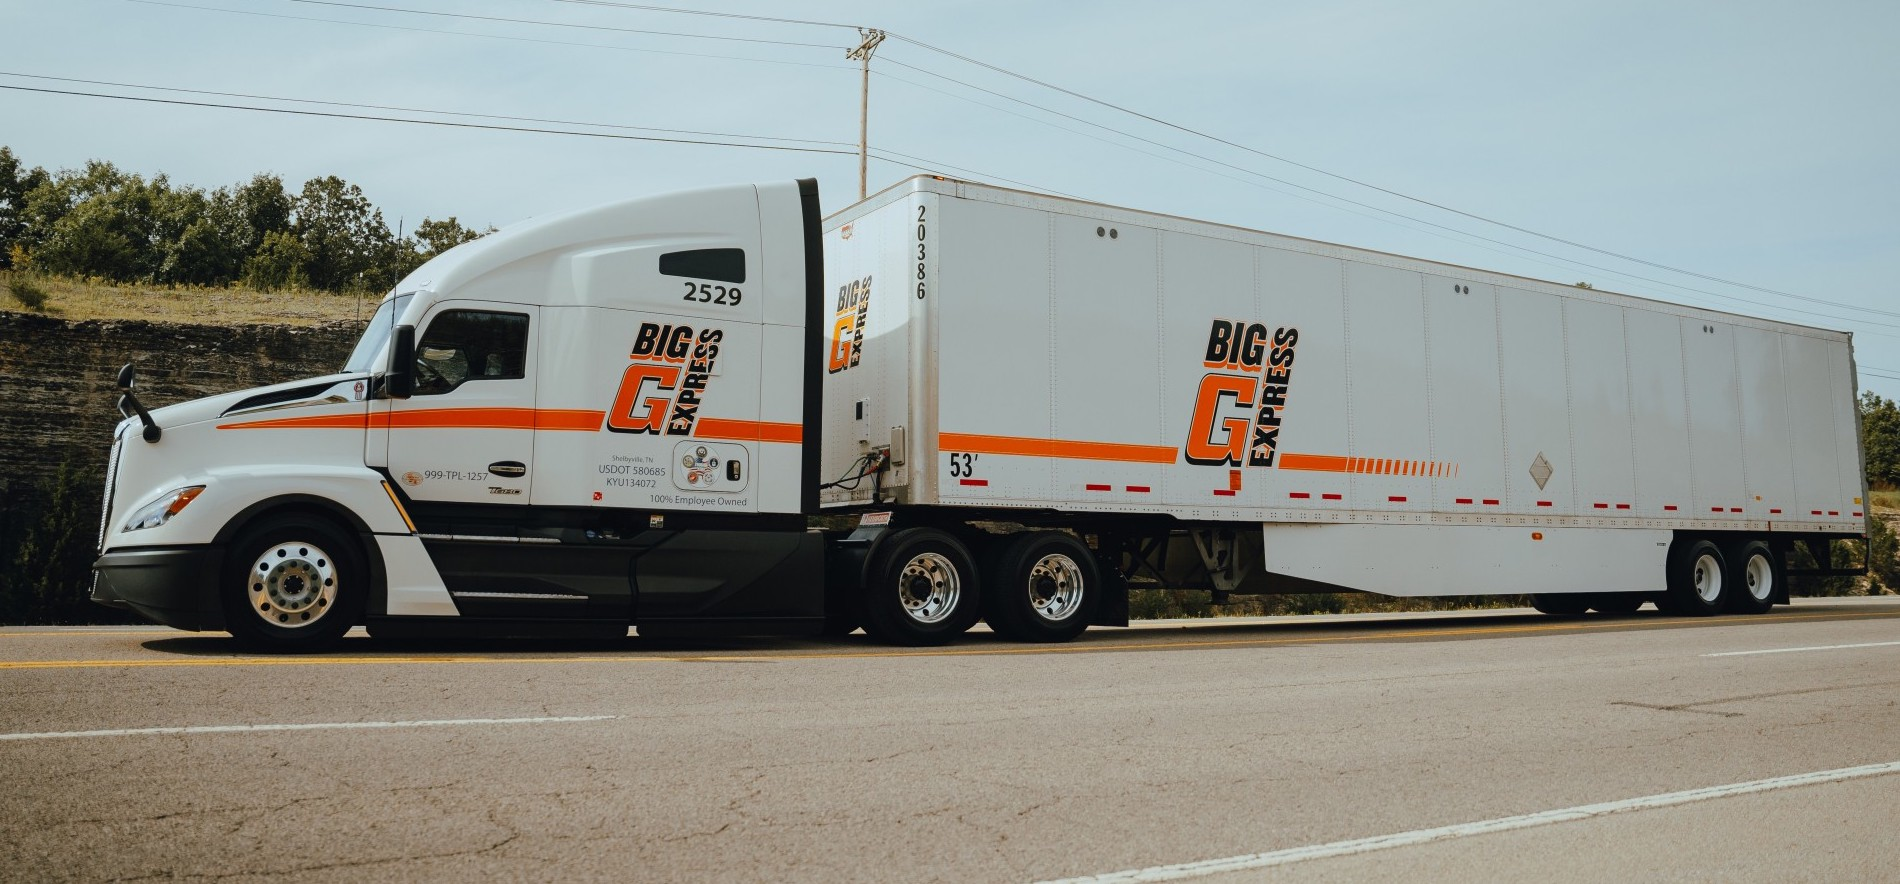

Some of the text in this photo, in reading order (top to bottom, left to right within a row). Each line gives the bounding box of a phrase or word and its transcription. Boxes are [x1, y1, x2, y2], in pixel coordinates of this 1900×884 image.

[917, 205, 926, 299] 20386
[683, 282, 742, 306] 2529
[836, 279, 860, 316] BIG
[629, 321, 694, 363] BIG
[849, 274, 873, 369] EXPRESS
[828, 313, 856, 375] G
[1203, 318, 1268, 373] BIG
[606, 362, 683, 436] G
[663, 328, 724, 437] EXPRESS
[1246, 327, 1299, 468] EXPRESS
[1184, 372, 1260, 468] G
[424, 470, 489, 481] 999-TPL-1257
[599, 464, 666, 477] USDOT 580685
[611, 455, 654, 464] Shelbyville, TN
[950, 452, 978, 478] 53'
[606, 478, 656, 488] KYU134072
[651, 494, 747, 507] 100% Employee Owned
